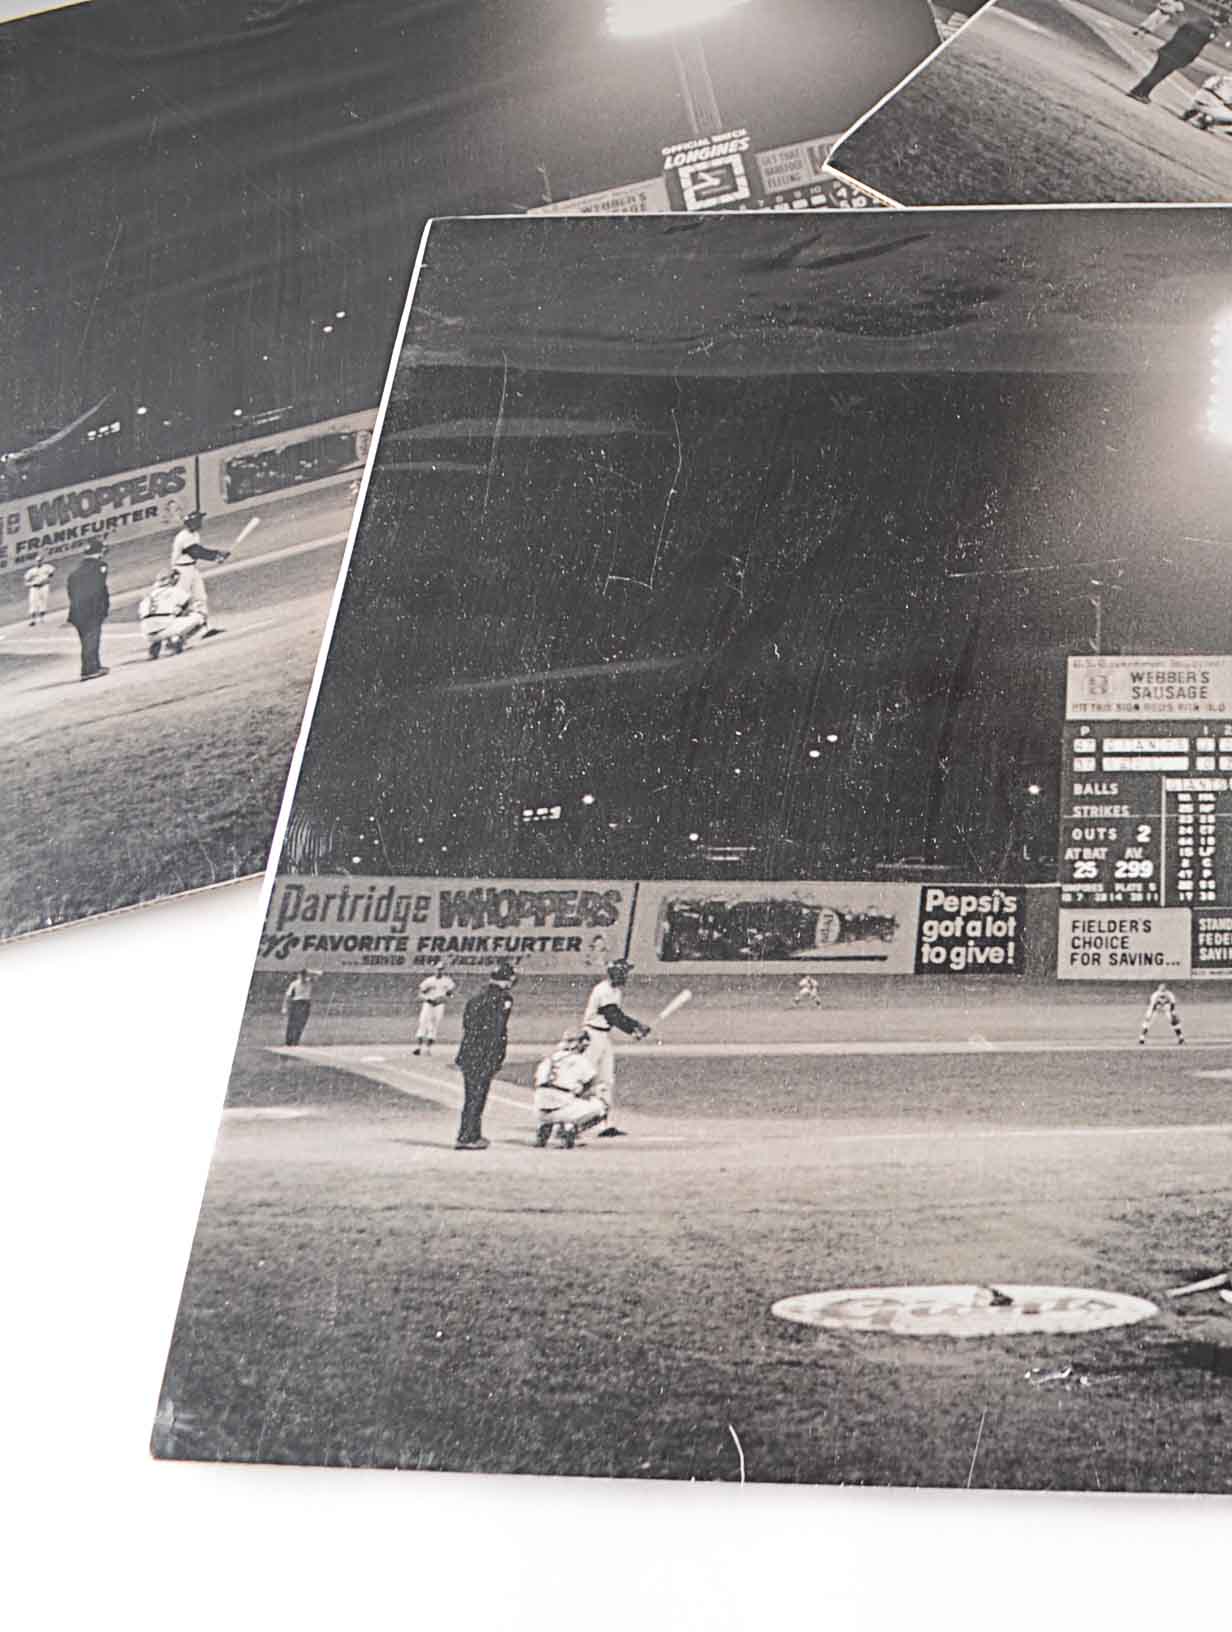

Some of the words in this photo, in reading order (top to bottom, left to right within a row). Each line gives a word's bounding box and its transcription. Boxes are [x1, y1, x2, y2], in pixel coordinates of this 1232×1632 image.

[664, 136, 751, 170] LONGINES
[27, 466, 187, 532] WHOPPERS
[15, 506, 159, 554] FRANKFURTER
[1131, 685, 1209, 699] SAUSAGE
[1073, 784, 1119, 795] BALLS
[1073, 805, 1130, 817] STRIKES
[1072, 828, 1118, 840] OUTS
[1136, 825, 1151, 842] 2
[1064, 848, 1082, 859] AT
[1073, 861, 1098, 878] 25
[1114, 860, 1154, 878] 299
[278, 883, 432, 933] Partridge
[438, 887, 622, 931] WHOPPERS
[925, 889, 1017, 915] Pepsi's
[922, 916, 964, 941] got
[966, 920, 983, 938] a
[985, 916, 1017, 938] lot
[1071, 919, 1153, 933] FIELDER'S
[301, 934, 409, 952] FAVORITE
[416, 934, 584, 953] FRANKFURTER
[1071, 936, 1130, 950] CHOICE
[920, 942, 948, 965] to
[950, 942, 1015, 970] give!
[1070, 952, 1101, 966] FOR
[1109, 952, 1181, 966] SAVING...
